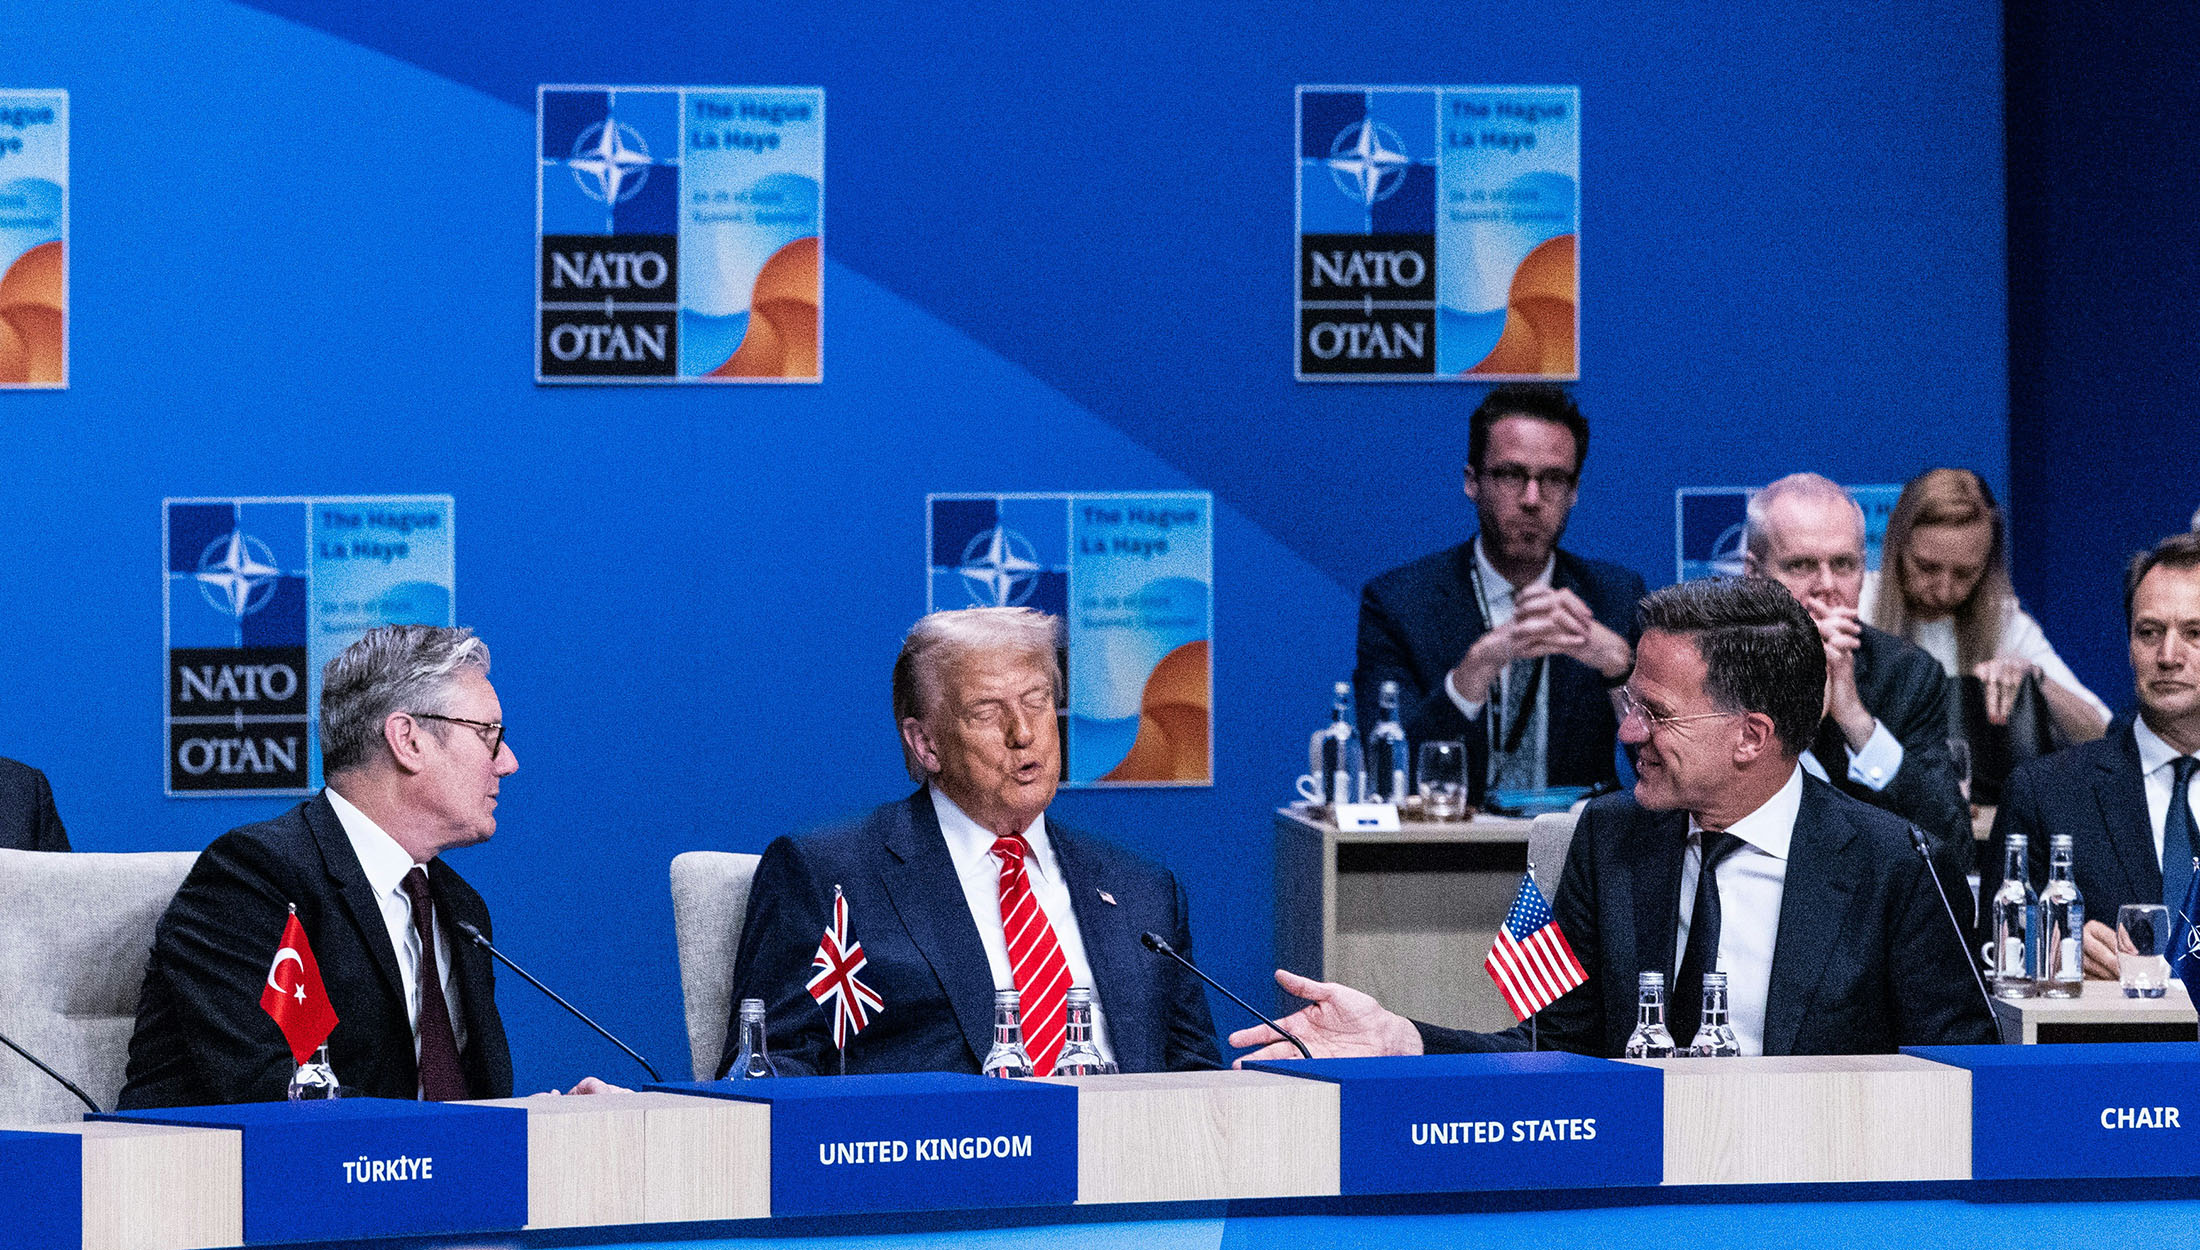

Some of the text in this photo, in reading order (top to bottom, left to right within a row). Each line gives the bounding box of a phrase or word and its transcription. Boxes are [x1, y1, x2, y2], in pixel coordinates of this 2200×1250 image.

[695, 101, 811, 125] The Hague
[1452, 101, 1567, 124] The Hague
[692, 131, 780, 153] La Haye
[1449, 131, 1537, 153] La Haye
[552, 251, 668, 288] NATO
[1312, 250, 1426, 287] NATO
[549, 324, 667, 361] OTAN
[1308, 322, 1425, 359] OTAN
[323, 511, 440, 535] The Hague
[1083, 507, 1198, 529] The Hague
[320, 541, 409, 563] La Haye
[1081, 537, 1169, 560] La Haye
[180, 664, 298, 701] NATO
[178, 737, 297, 775] OTAN
[2100, 1106, 2181, 1130] CHAIR
[1411, 1117, 1597, 1146] UNITED STATES
[819, 1134, 1032, 1166] UNITED KINGDOM
[342, 1154, 433, 1184] TÜRKİYE
